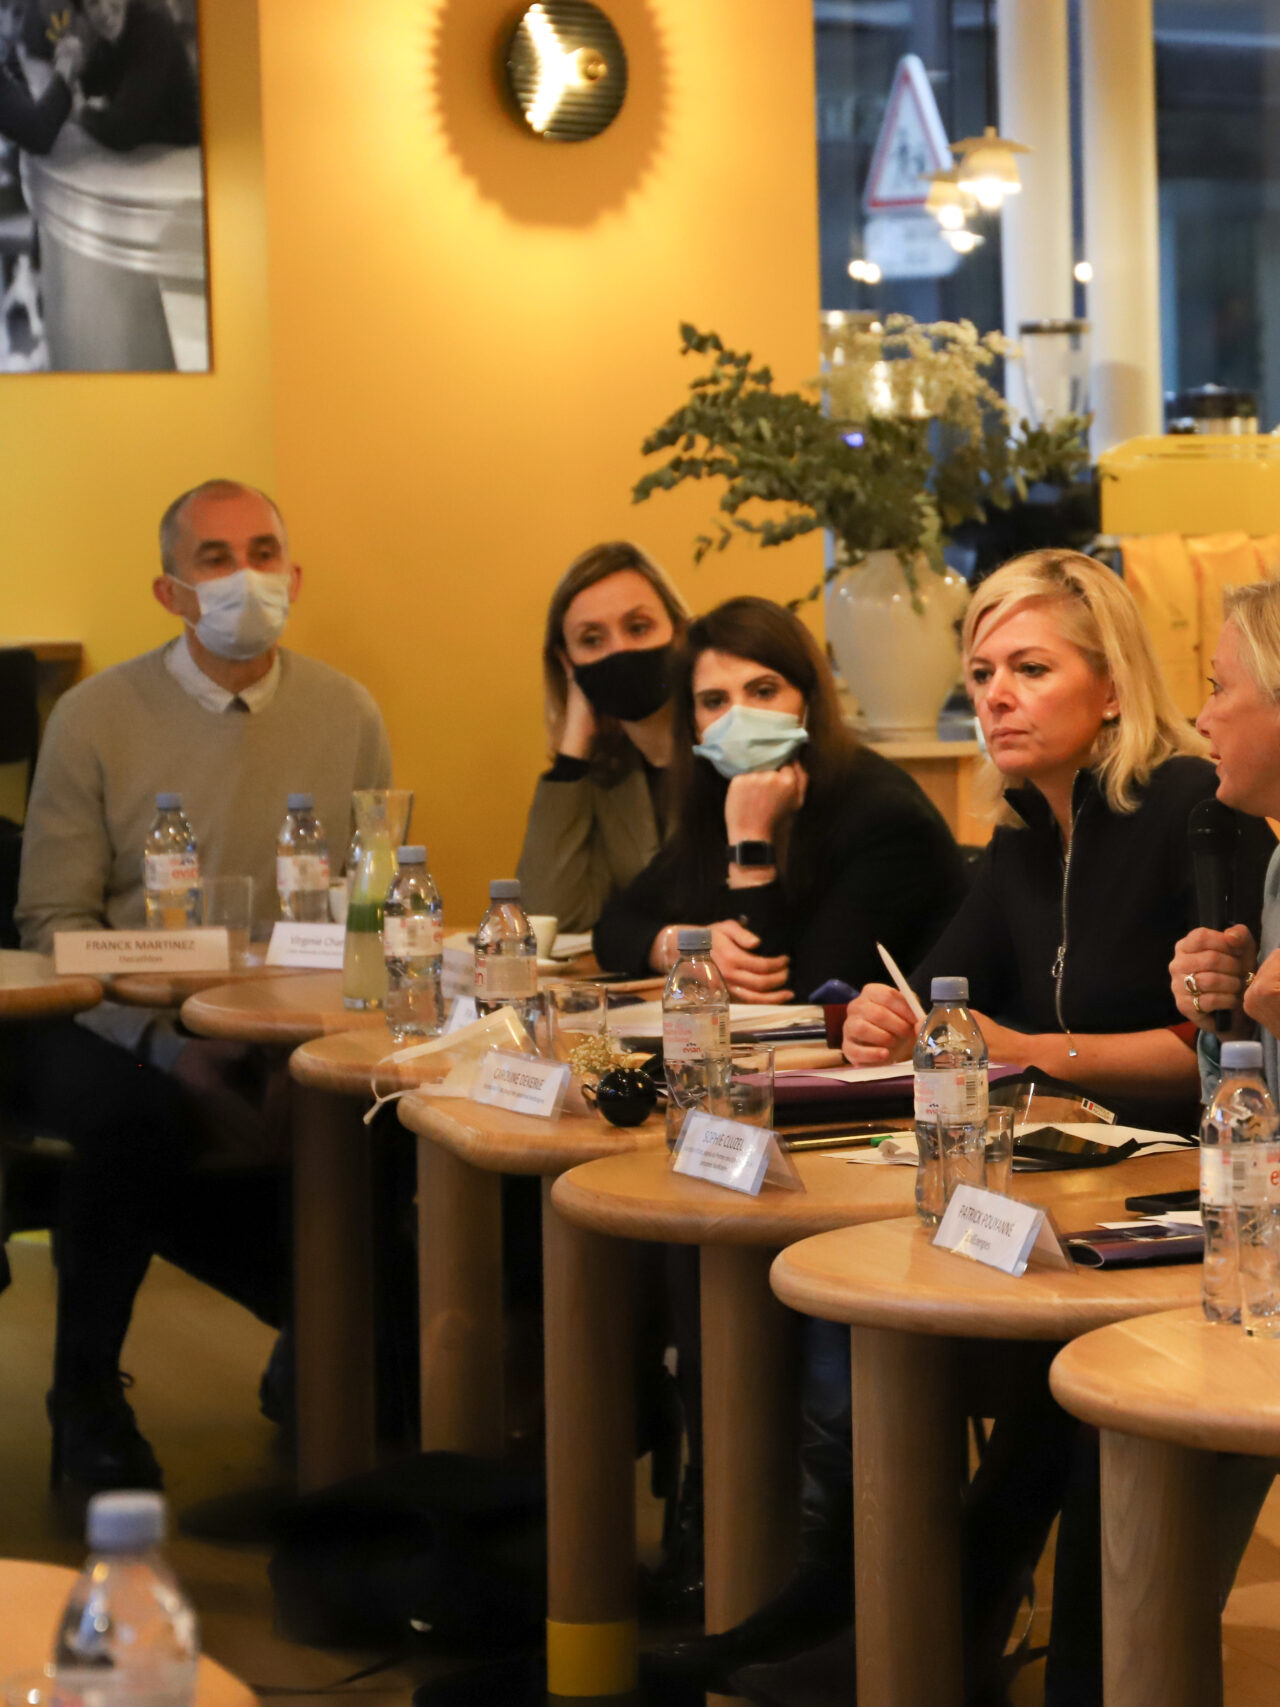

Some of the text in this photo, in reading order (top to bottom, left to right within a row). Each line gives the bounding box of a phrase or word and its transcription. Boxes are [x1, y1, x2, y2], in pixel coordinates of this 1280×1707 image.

[86, 939, 195, 950] FRANCK MARTINEZ
[959, 1204, 981, 1225] PATRICK
